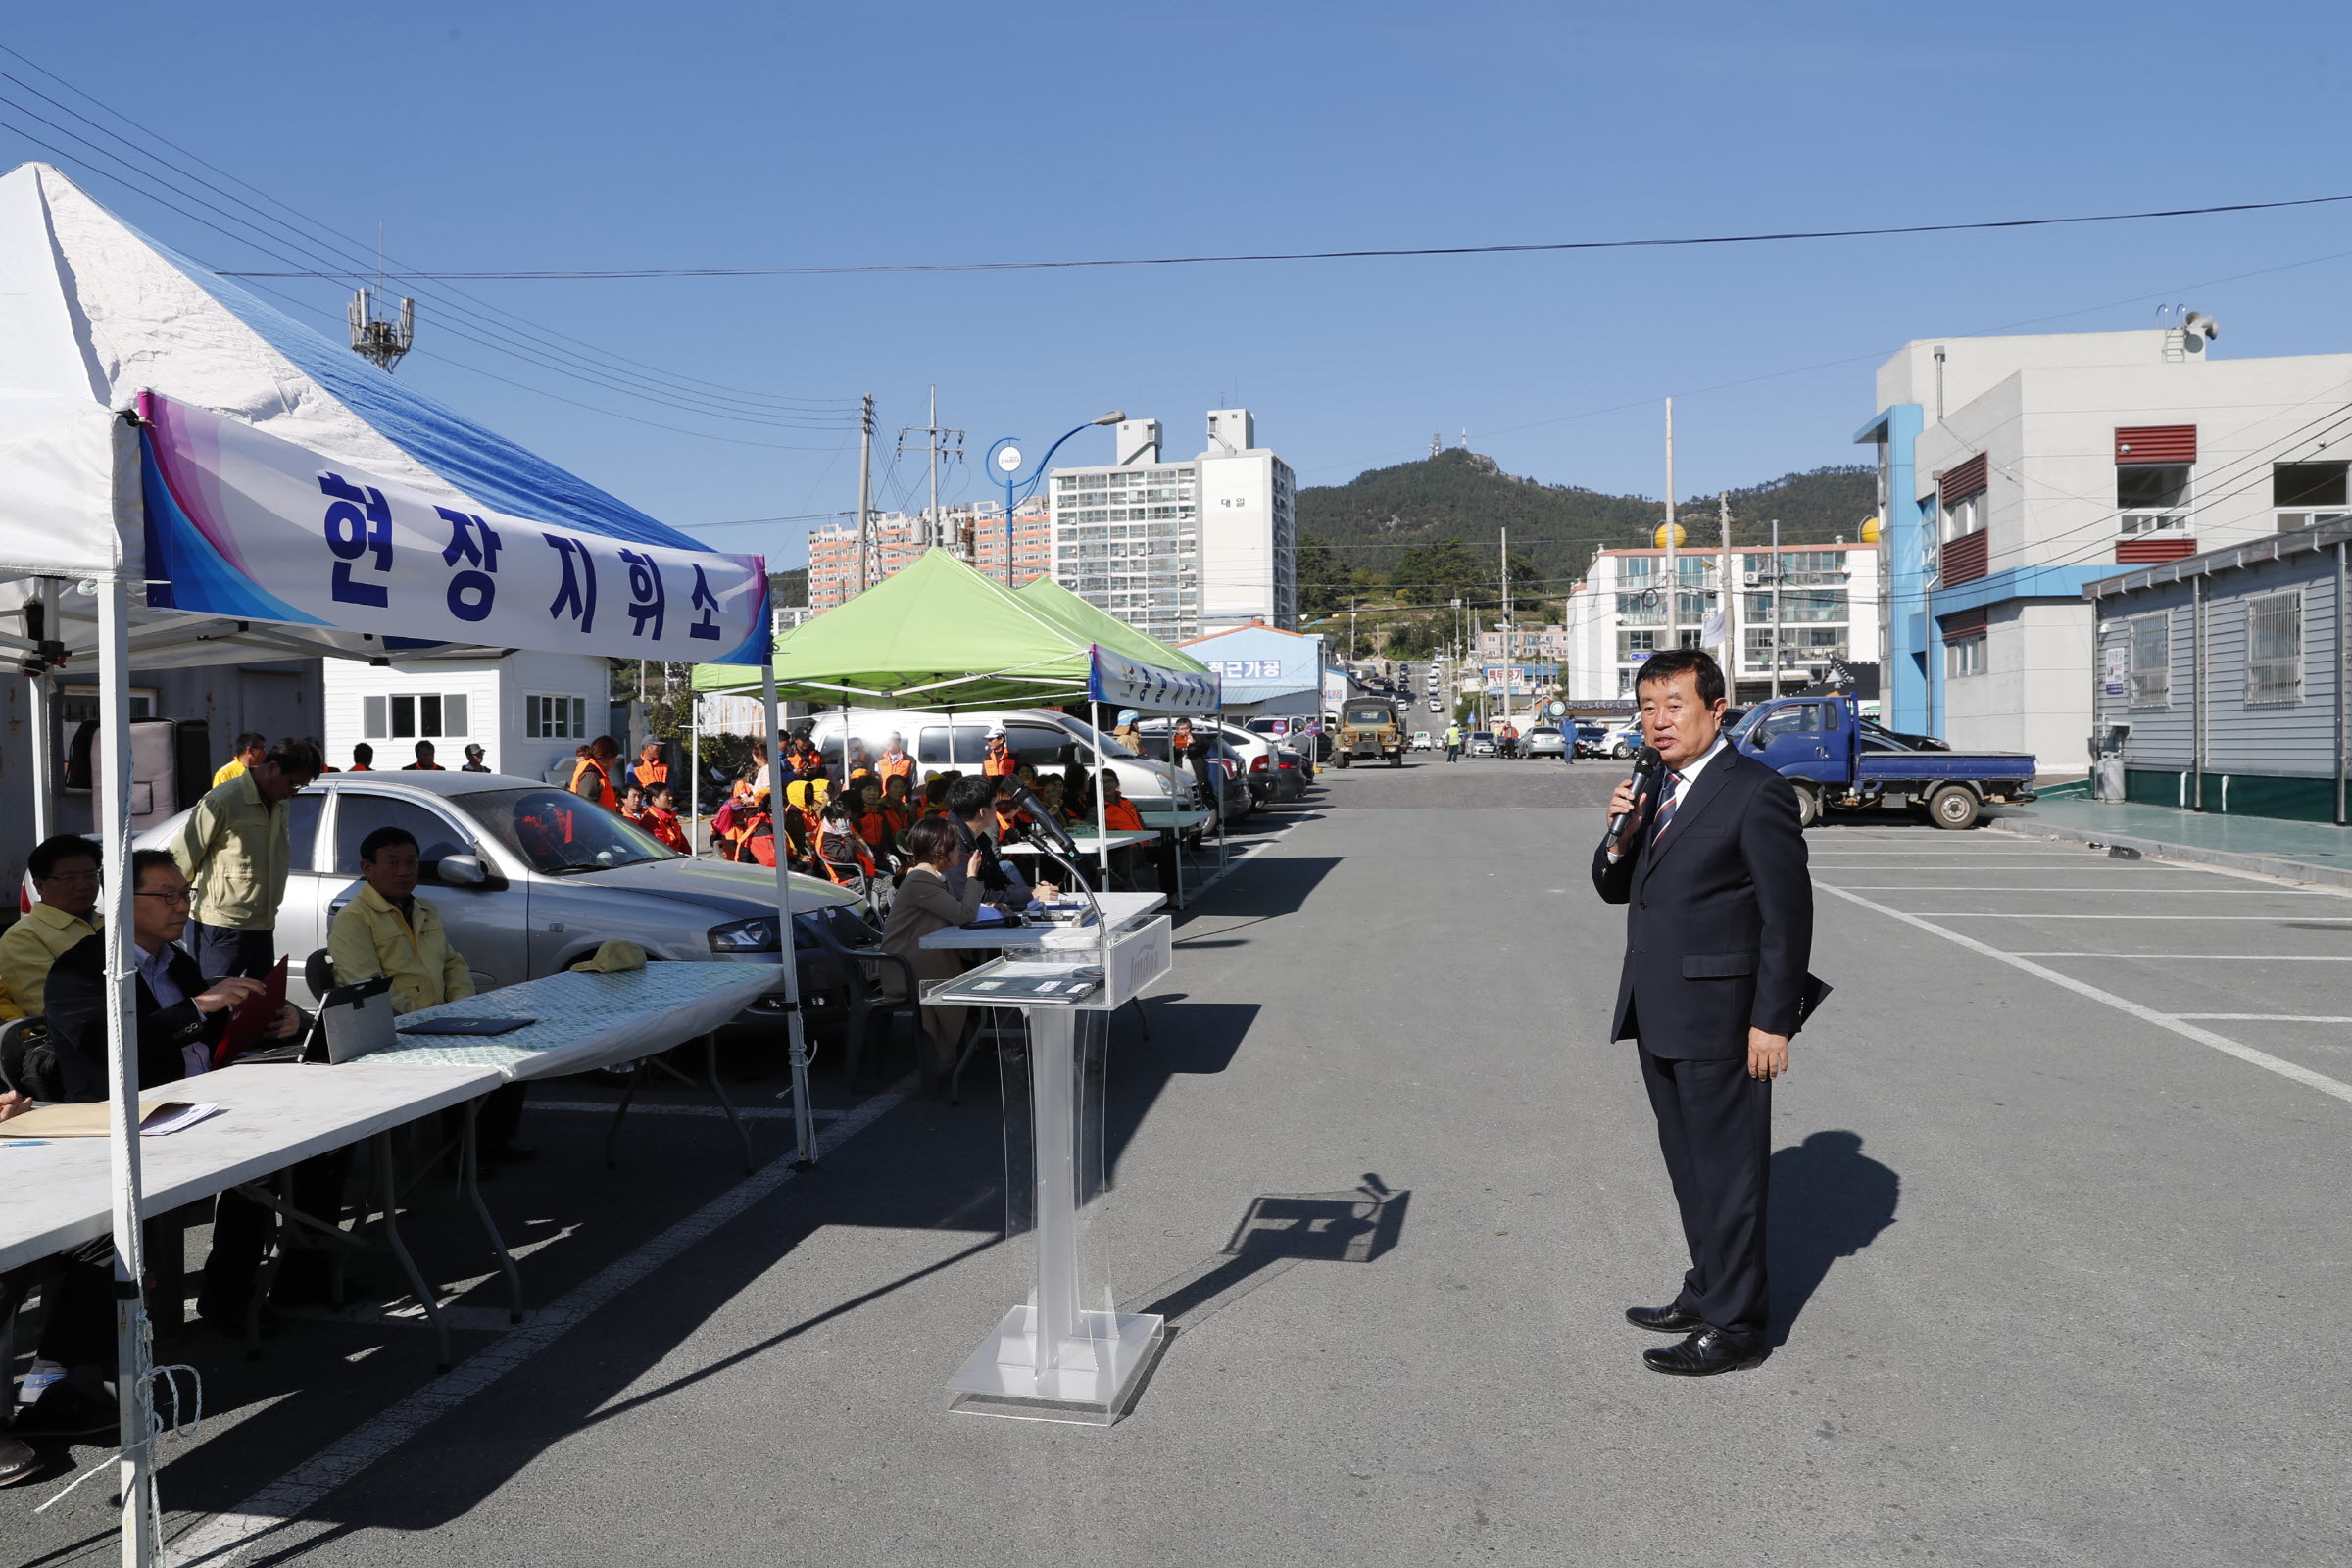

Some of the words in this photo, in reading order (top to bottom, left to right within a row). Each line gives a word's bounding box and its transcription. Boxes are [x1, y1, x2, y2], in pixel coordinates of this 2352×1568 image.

[1220, 497, 1245, 508] 대일
[315, 470, 721, 641] 현장지휘소
[1201, 660, 1280, 678] 철근가공
